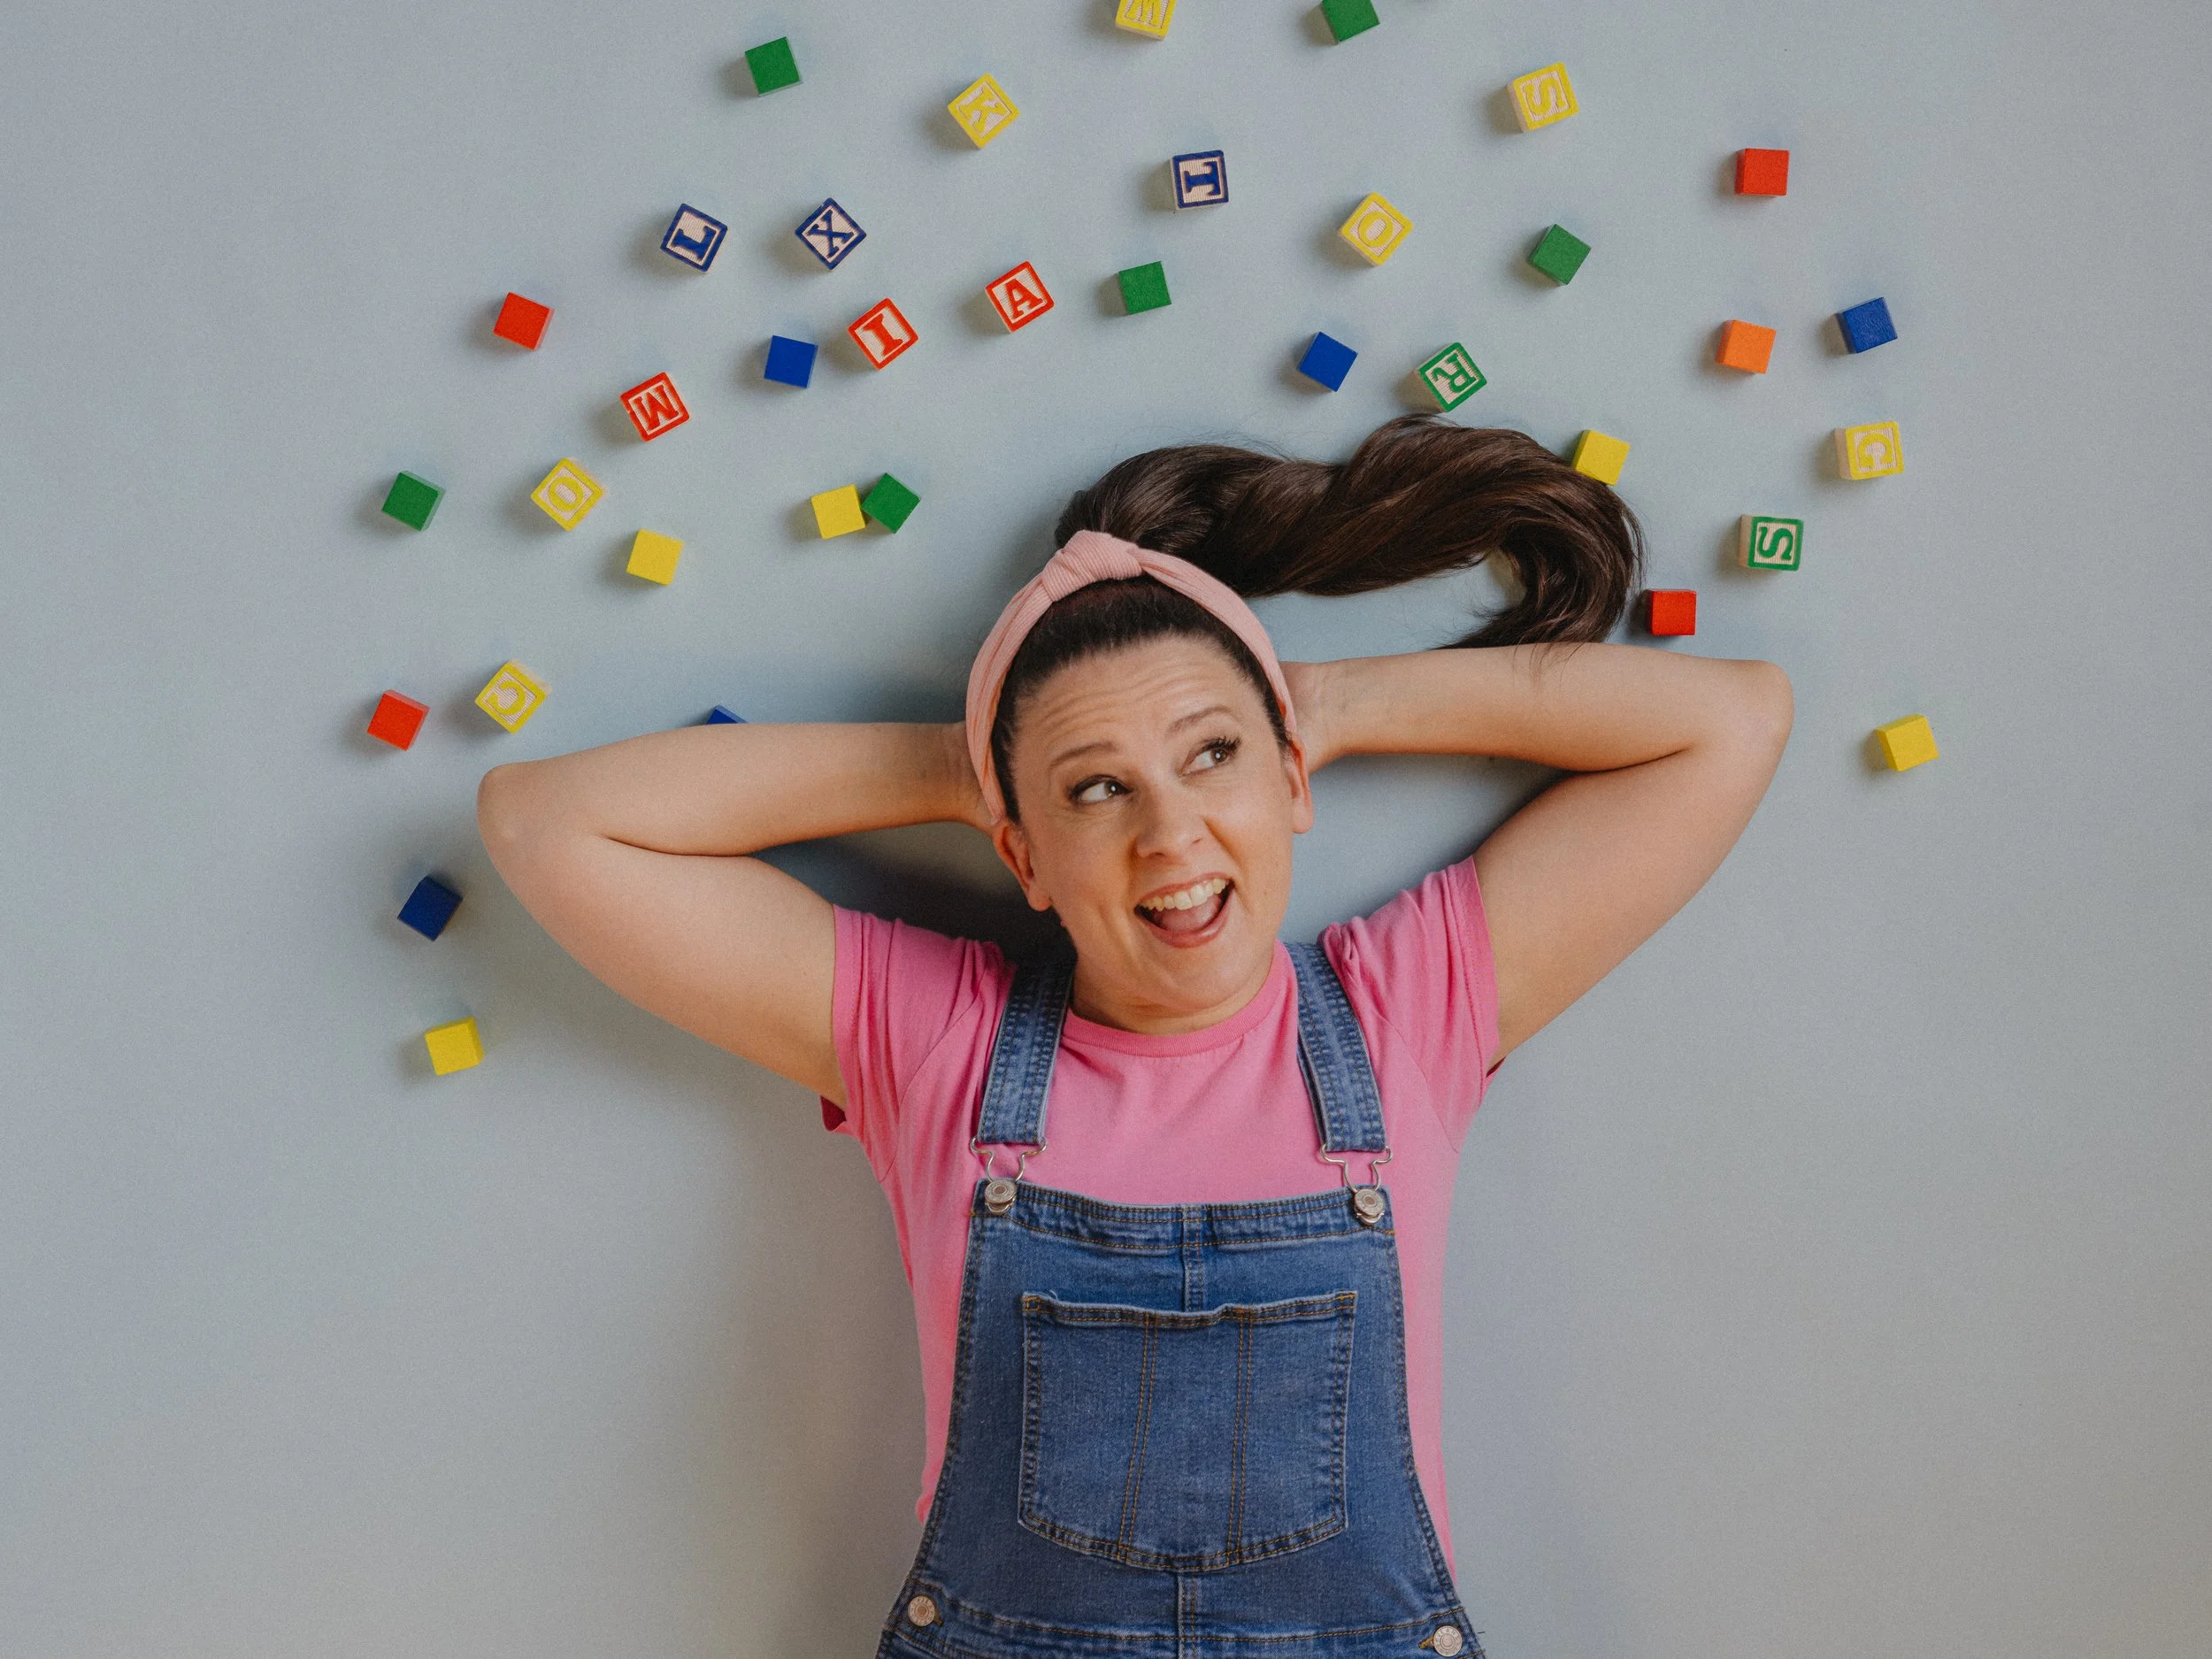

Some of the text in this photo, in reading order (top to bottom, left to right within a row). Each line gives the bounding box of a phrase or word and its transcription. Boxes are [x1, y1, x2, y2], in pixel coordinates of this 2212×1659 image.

[959, 86, 1008, 133] K
[1524, 77, 1566, 116] S
[671, 226, 717, 261] L
[807, 210, 854, 258] X
[1358, 211, 1394, 248] O
[1003, 279, 1043, 319] A
[863, 312, 903, 356] I
[1432, 353, 1476, 393] R
[549, 476, 584, 511] O
[1758, 526, 1793, 560] S
[487, 680, 526, 716] C
